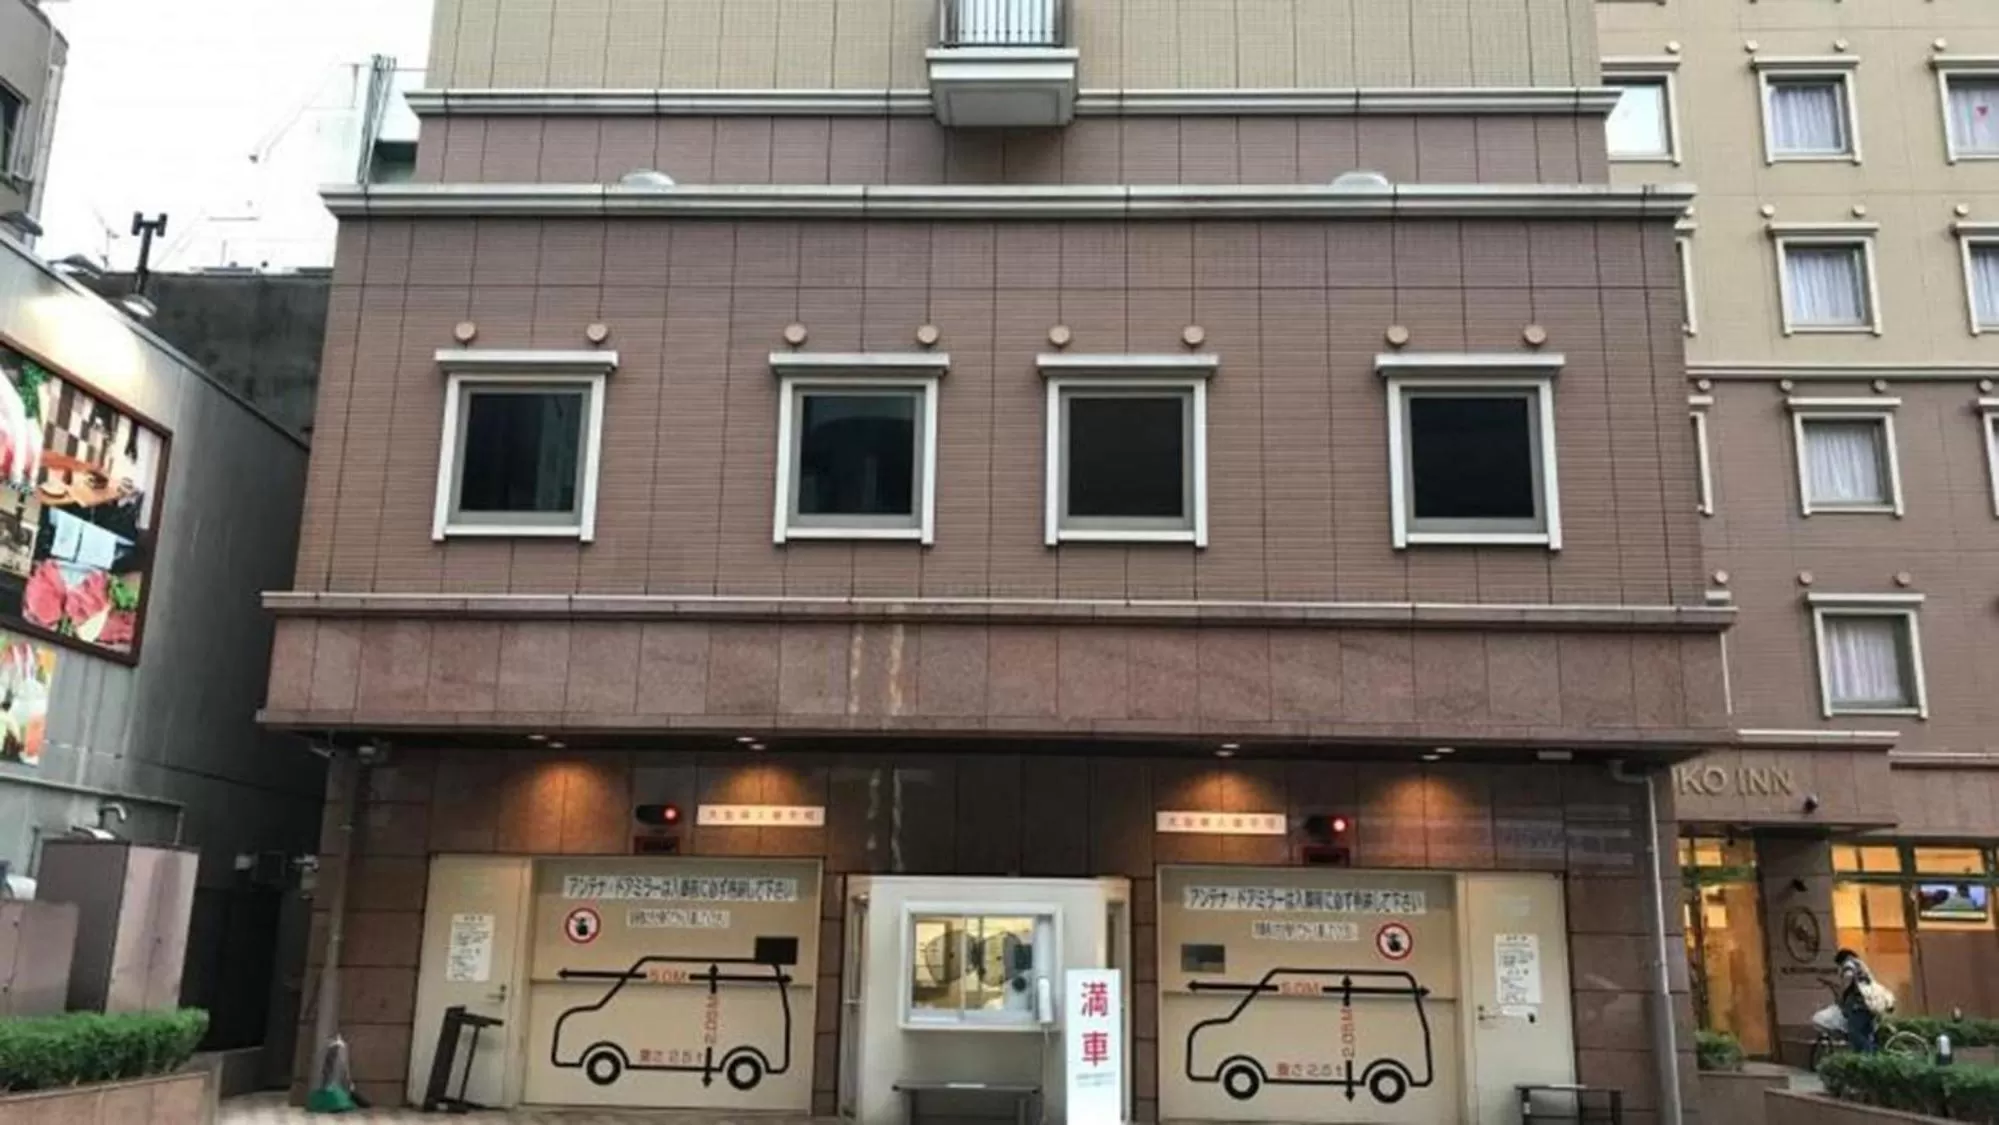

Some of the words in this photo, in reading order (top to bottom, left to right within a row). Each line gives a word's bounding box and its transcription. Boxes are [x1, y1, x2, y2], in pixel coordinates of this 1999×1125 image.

[1672, 765, 1729, 795] KO
[1735, 766, 1794, 796] INN
[1081, 981, 1110, 1068] 満車
